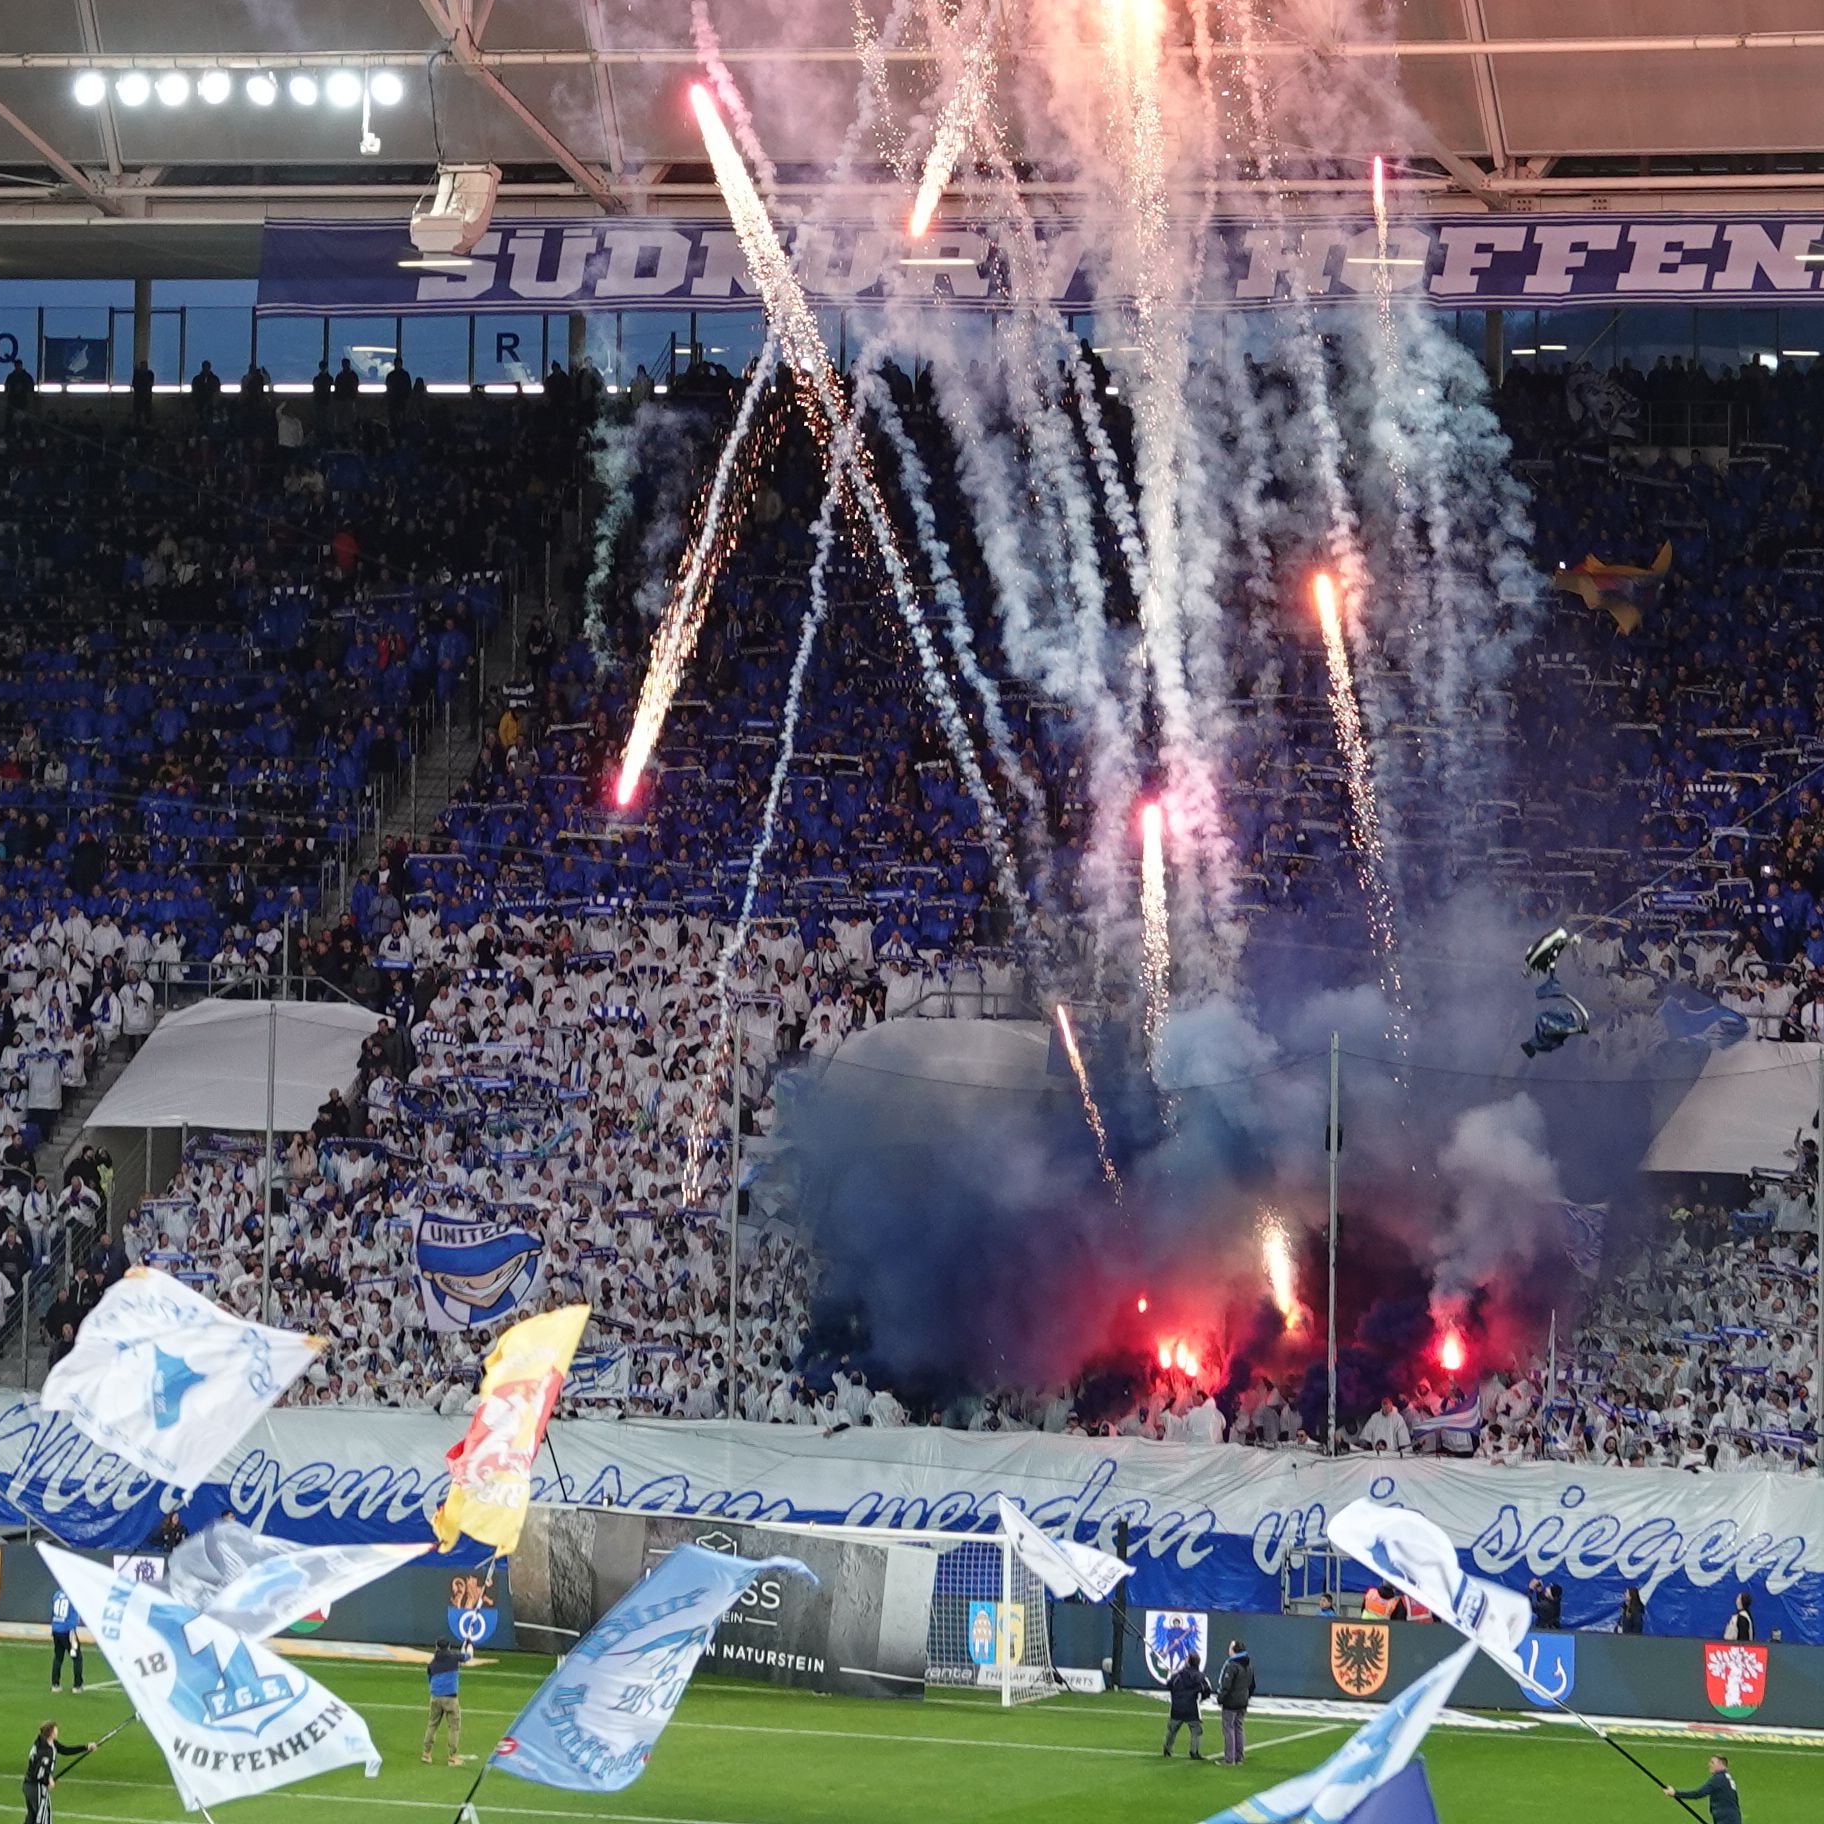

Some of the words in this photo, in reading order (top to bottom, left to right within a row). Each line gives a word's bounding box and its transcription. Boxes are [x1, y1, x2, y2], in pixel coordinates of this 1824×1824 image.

[496, 332, 522, 364] R
[430, 1222, 509, 1246] UNITED
[133, 1652, 169, 1678] 18
[723, 1643, 825, 1674] NATURSTEIN
[174, 1700, 349, 1773] HOFFENHEIM
